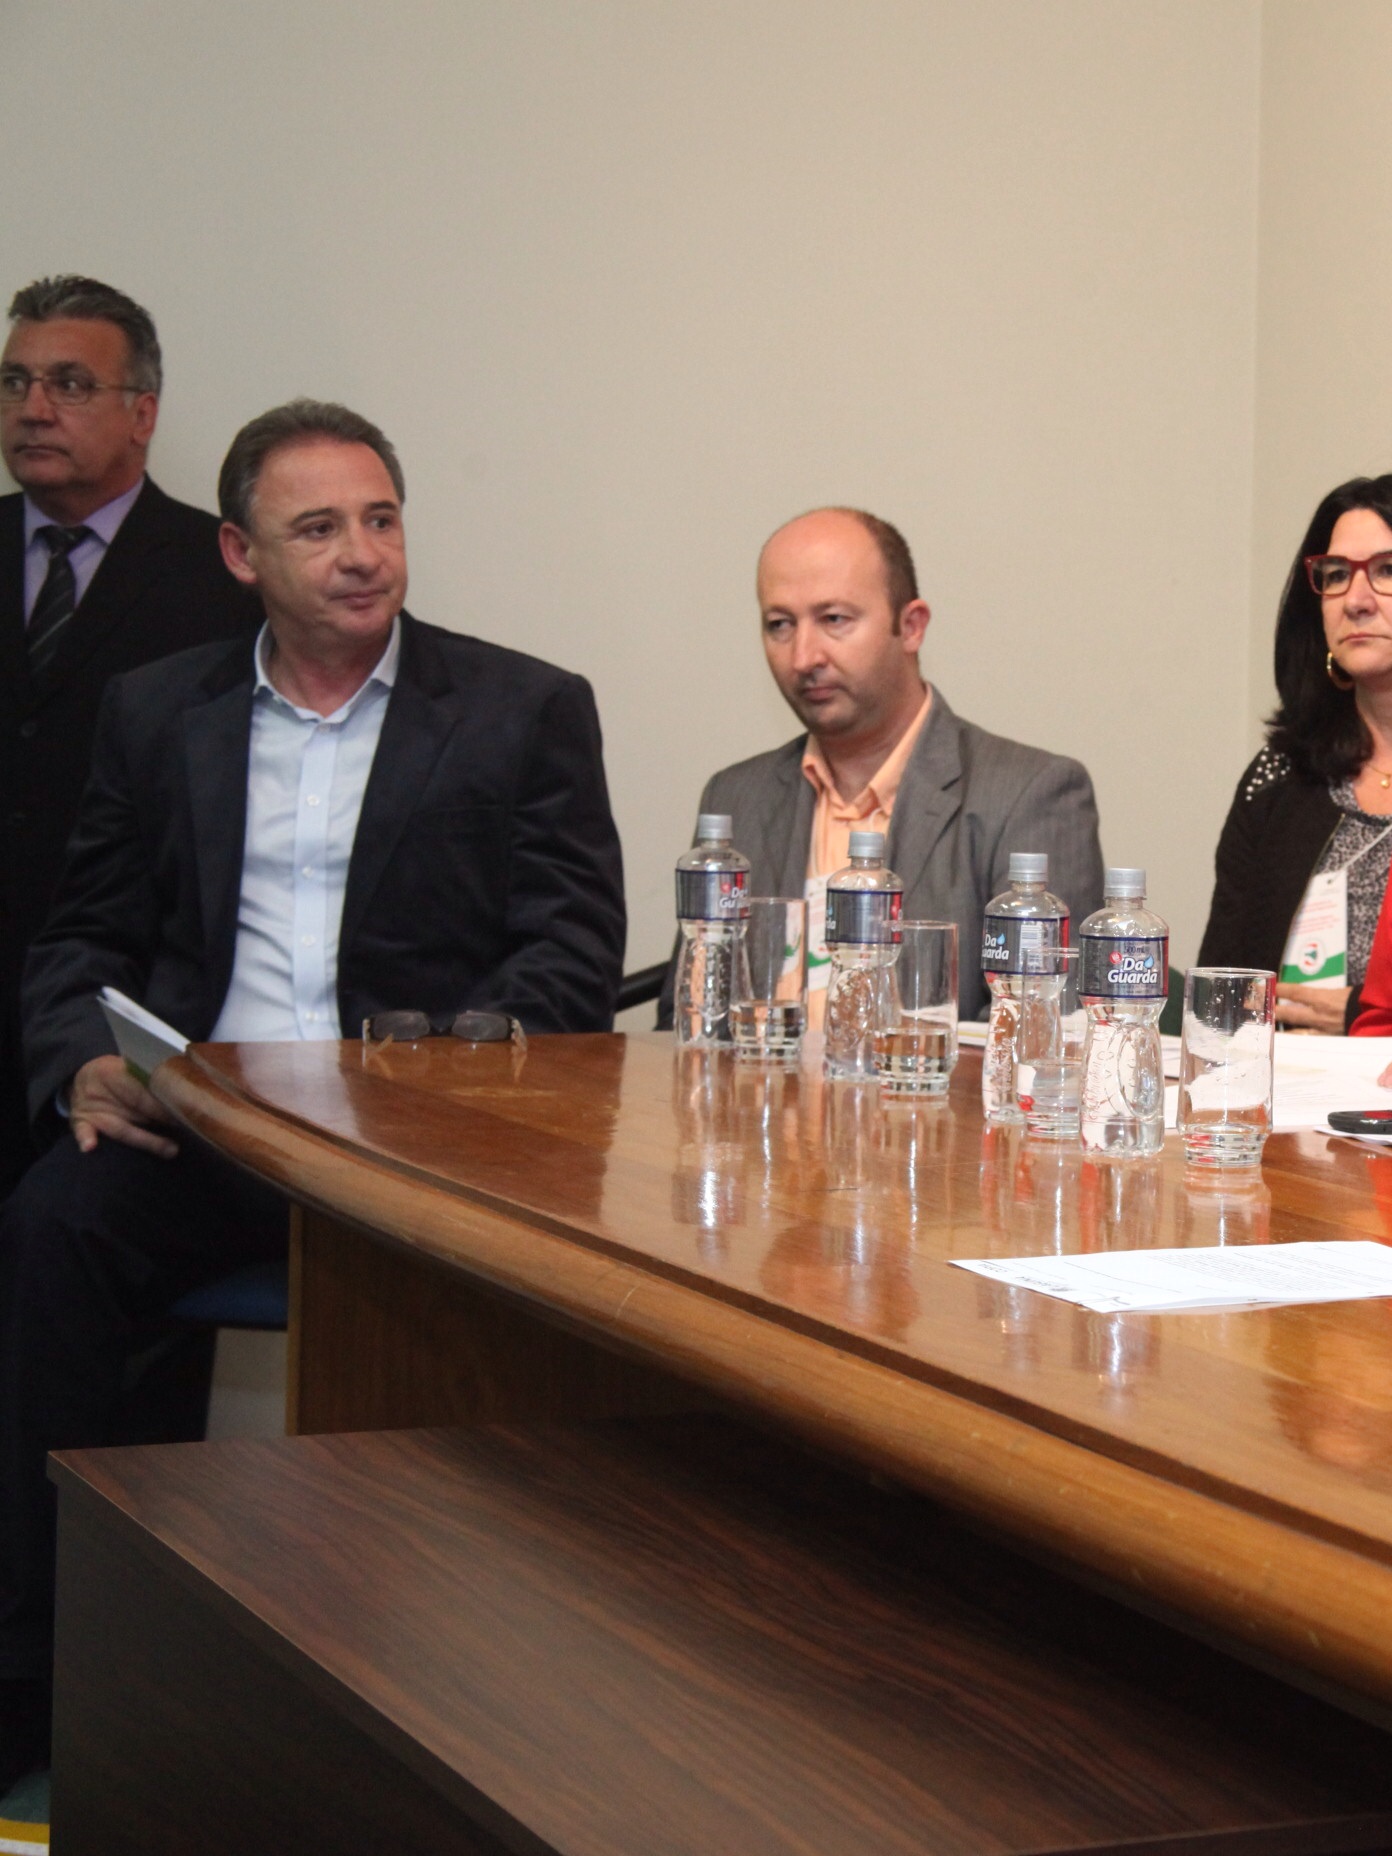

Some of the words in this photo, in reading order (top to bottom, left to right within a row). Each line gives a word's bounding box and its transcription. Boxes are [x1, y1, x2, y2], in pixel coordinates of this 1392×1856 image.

[981, 946, 1010, 960] uarda
[1123, 957, 1144, 971] Da
[1107, 969, 1158, 984] Guarda
